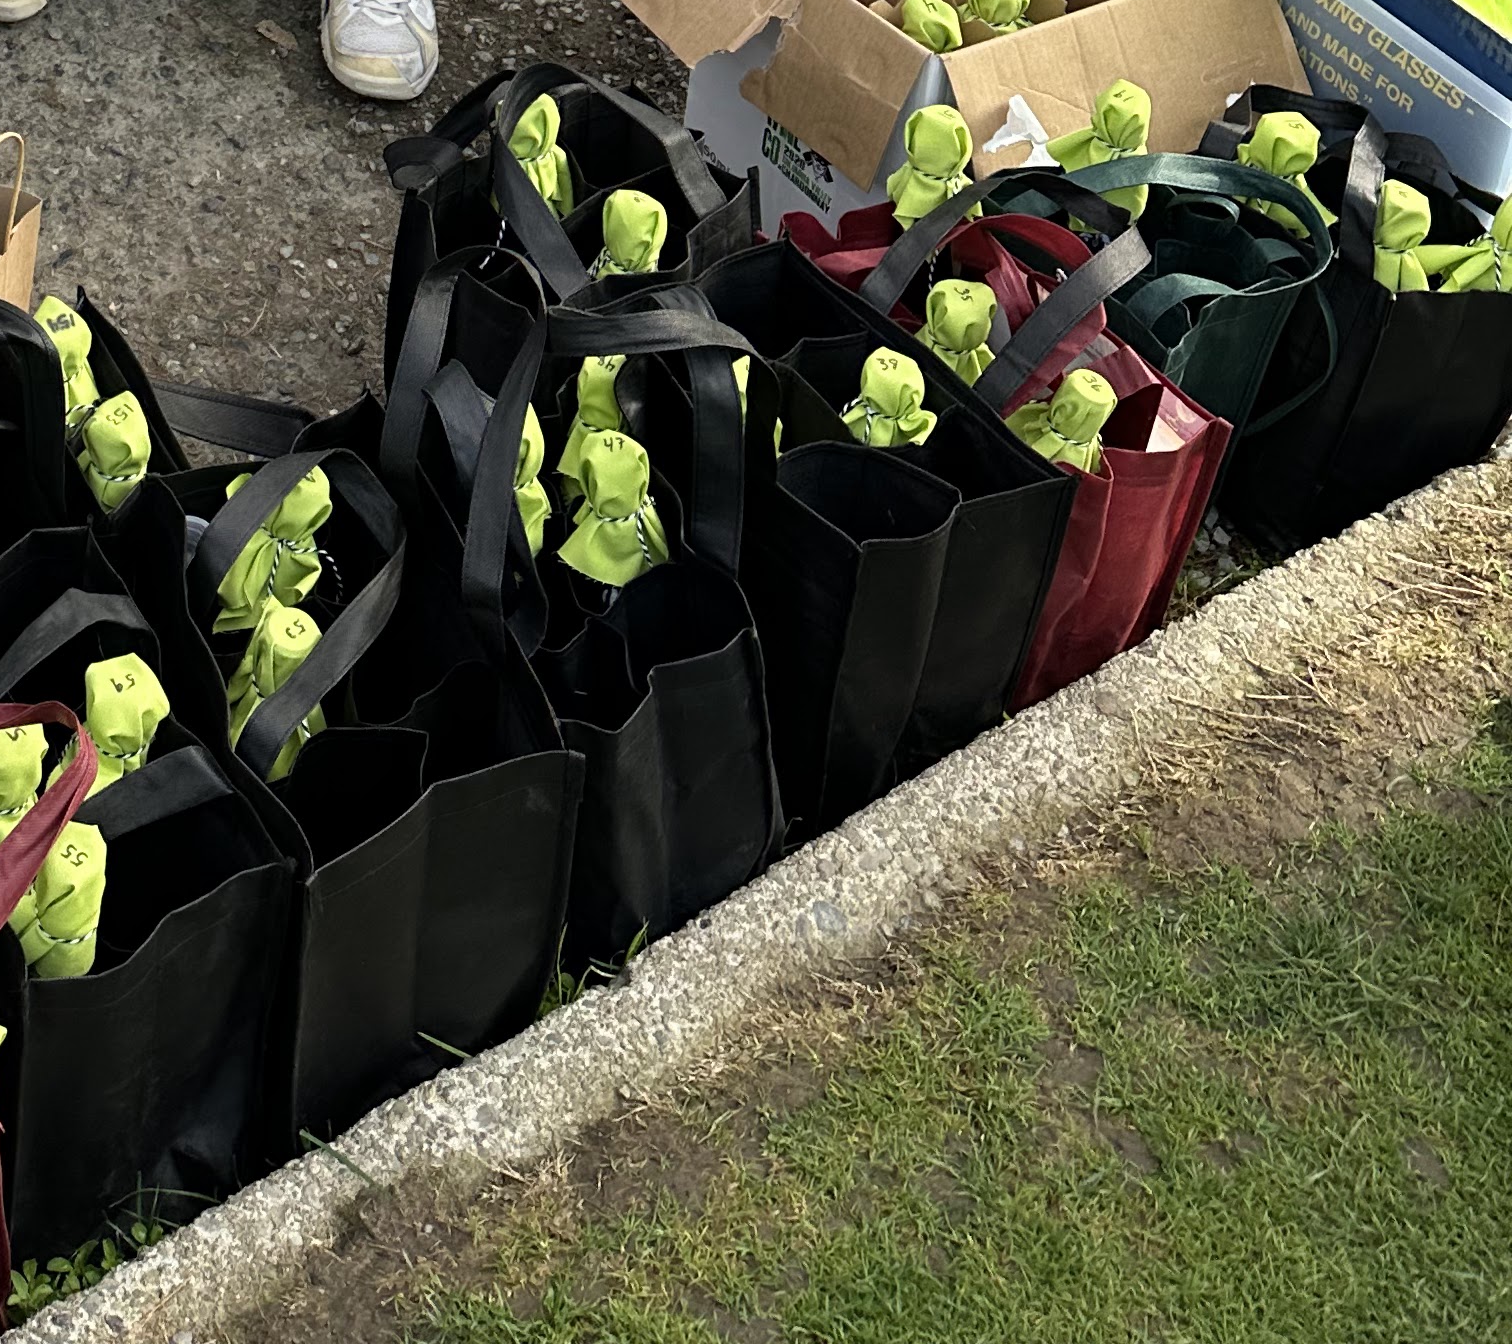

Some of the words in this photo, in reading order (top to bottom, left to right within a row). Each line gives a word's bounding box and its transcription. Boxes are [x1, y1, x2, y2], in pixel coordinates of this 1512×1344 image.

[1285, 7, 1321, 40] AND
[1322, 33, 1373, 81] MADE
[1375, 76, 1414, 113] FOR
[1367, 28, 1465, 110] GLASSES
[106, 403, 134, 425] 153
[603, 437, 625, 452] 47
[110, 673, 136, 693] 59
[60, 844, 89, 867] 55
